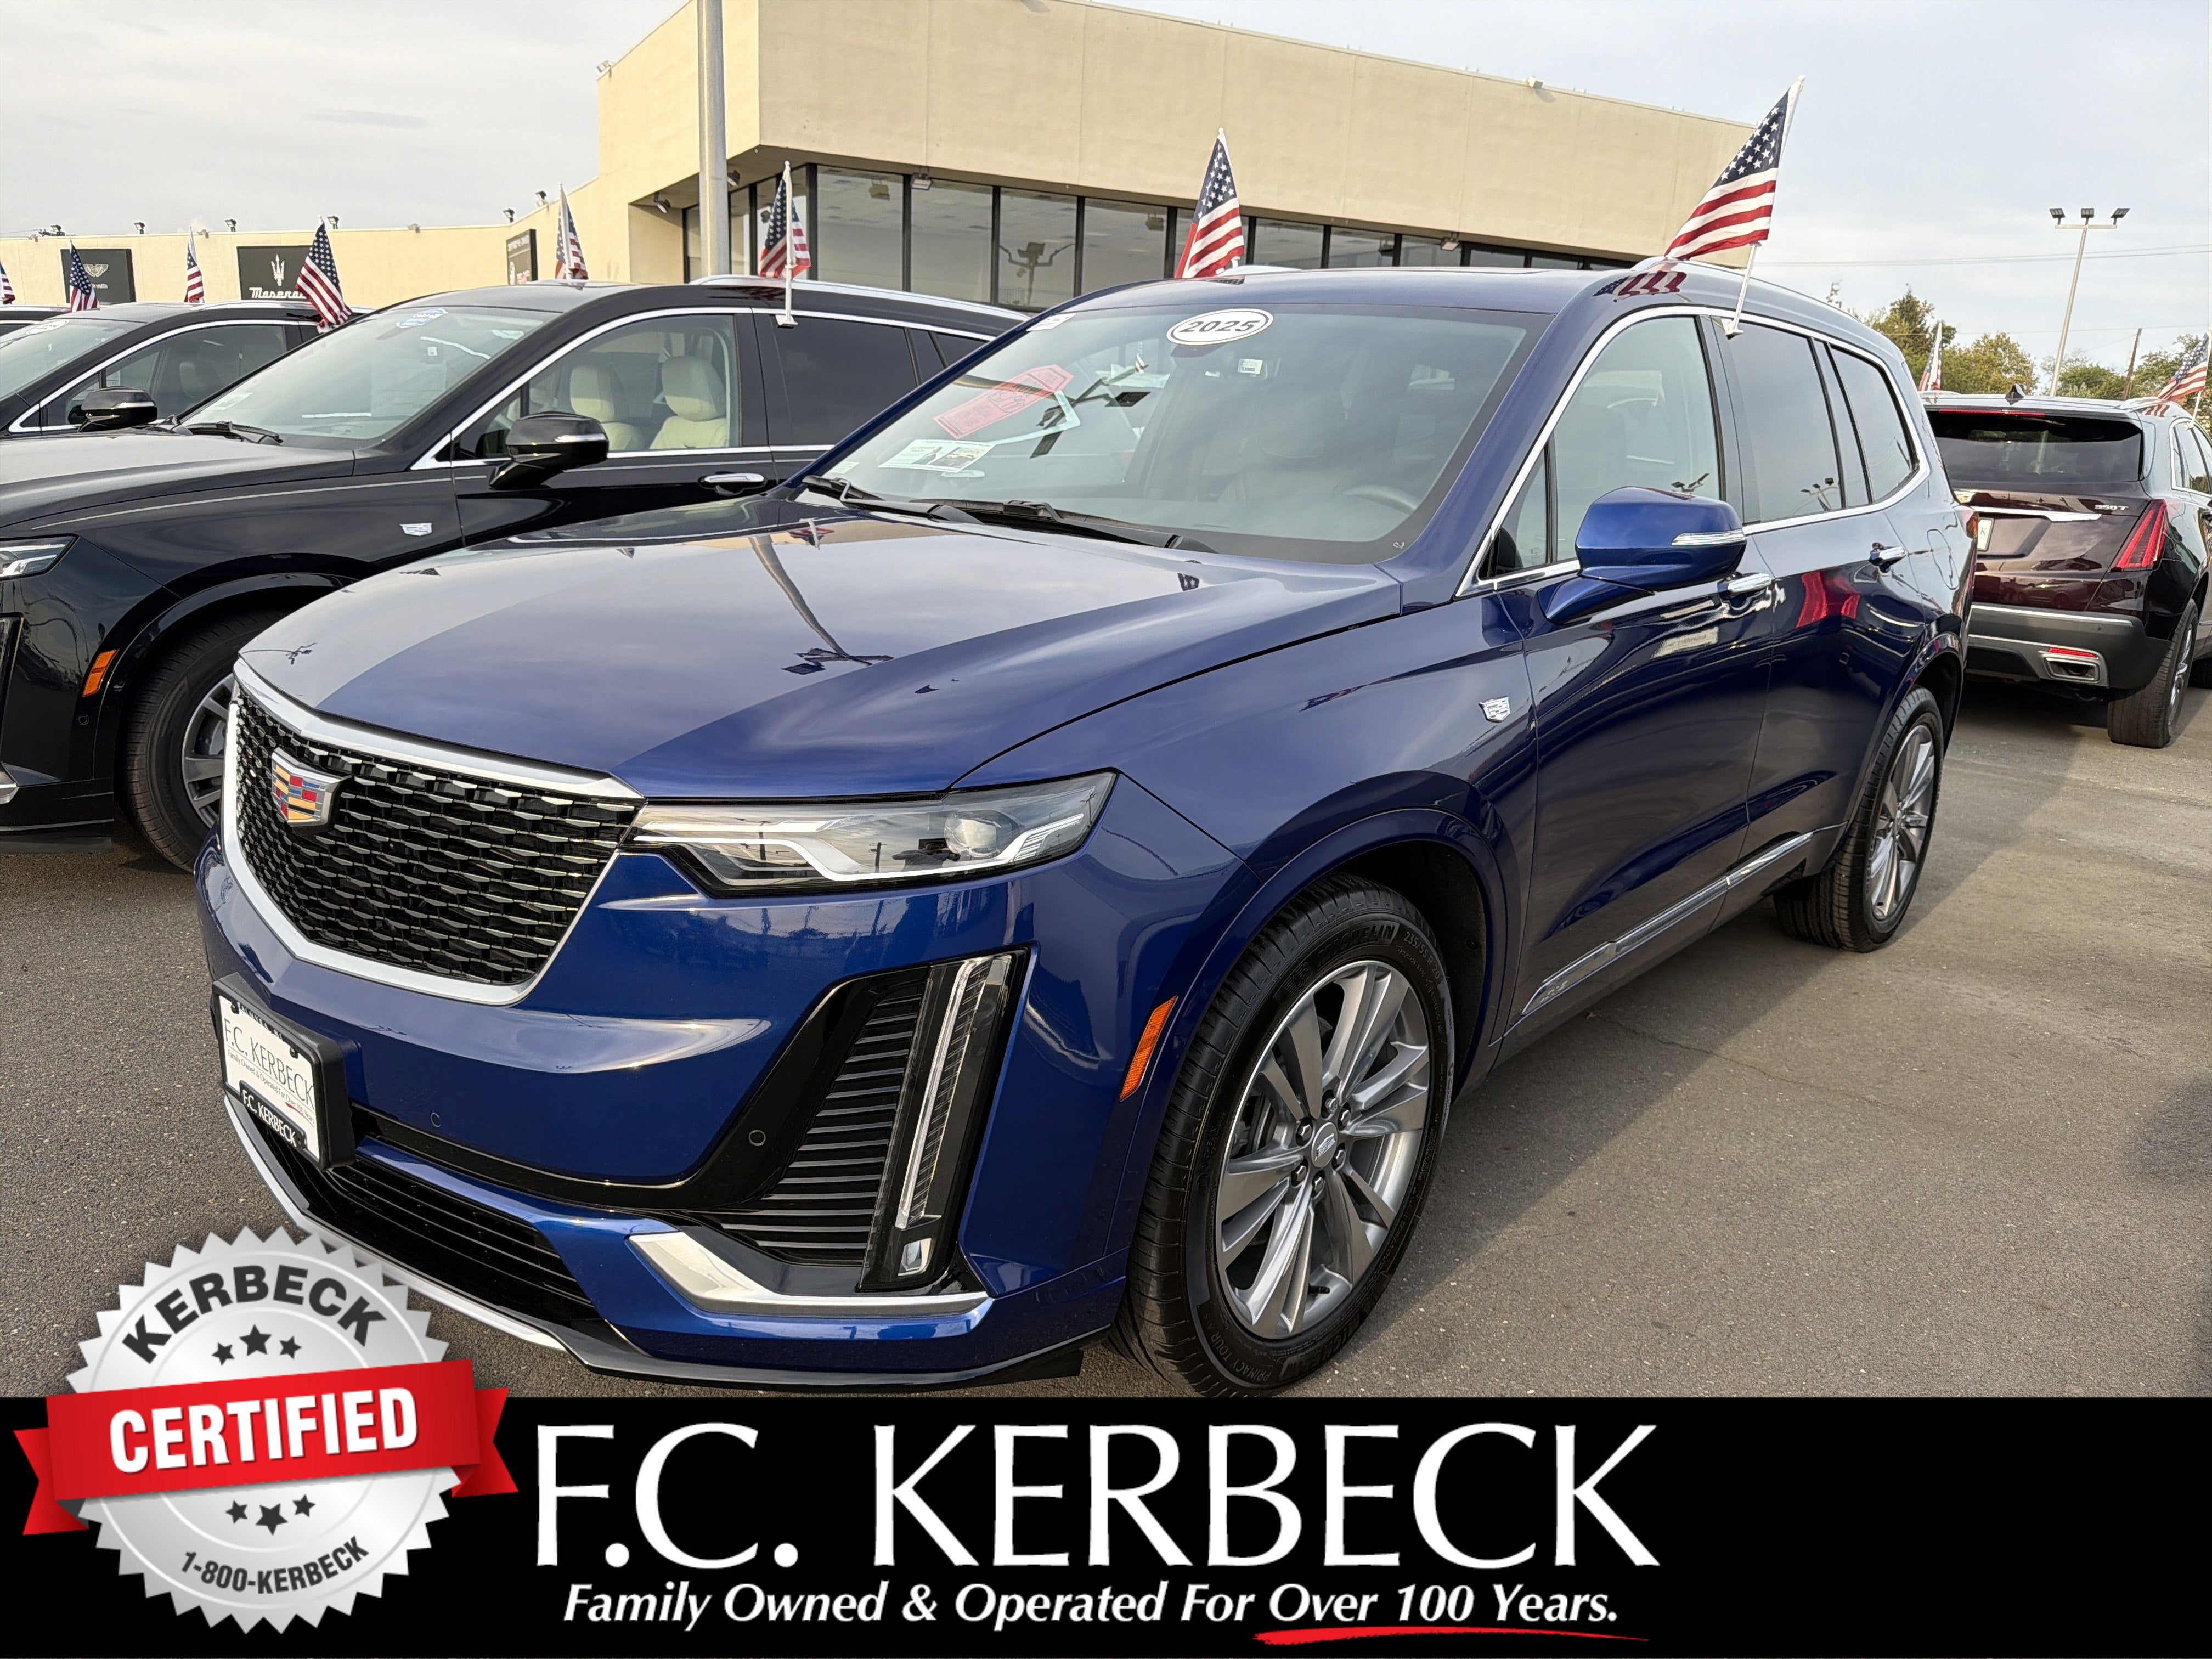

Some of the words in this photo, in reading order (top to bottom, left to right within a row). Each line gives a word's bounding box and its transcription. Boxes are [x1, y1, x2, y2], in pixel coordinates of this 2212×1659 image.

[1178, 320, 1261, 333] 2025
[1403, 931, 1429, 958] 235/55
[1431, 964, 1441, 979] 20
[224, 1018, 248, 1057] F.C.
[250, 1037, 315, 1111] KERBECK
[257, 1101, 298, 1148] KERBECK
[1210, 1330, 1234, 1362] TOUR
[1229, 1358, 1272, 1383] PRIMACY
